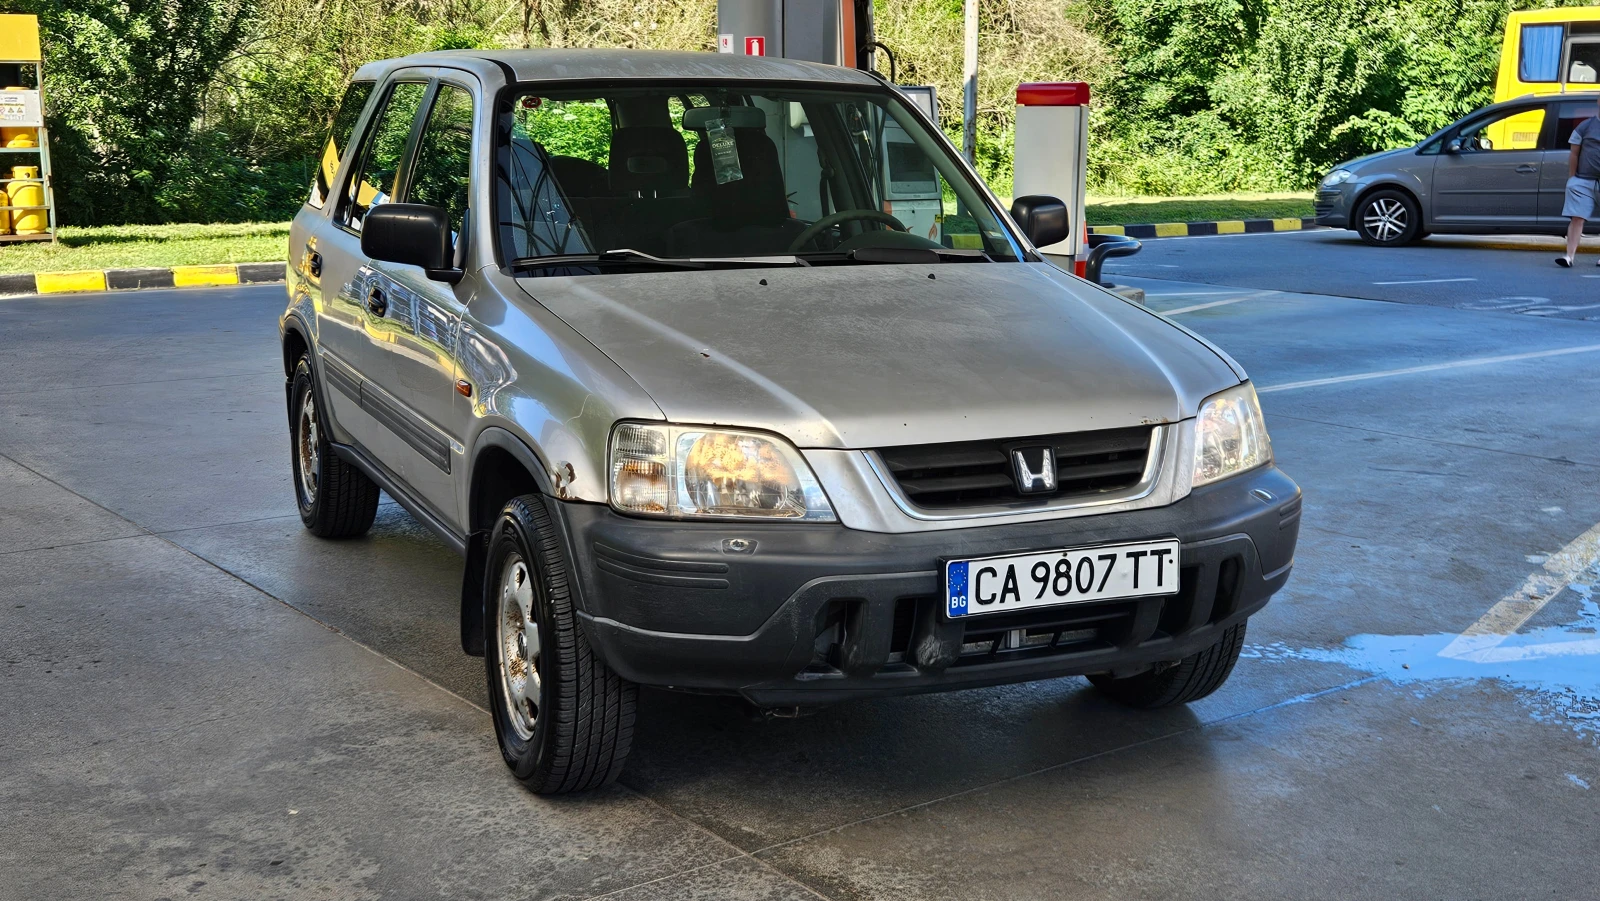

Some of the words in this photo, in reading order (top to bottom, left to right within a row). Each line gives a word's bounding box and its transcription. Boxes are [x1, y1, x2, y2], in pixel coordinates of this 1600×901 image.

[975, 563, 1021, 606] CA
[1030, 553, 1118, 600] 9807
[1126, 548, 1172, 590] TT
[951, 595, 967, 609] BG
